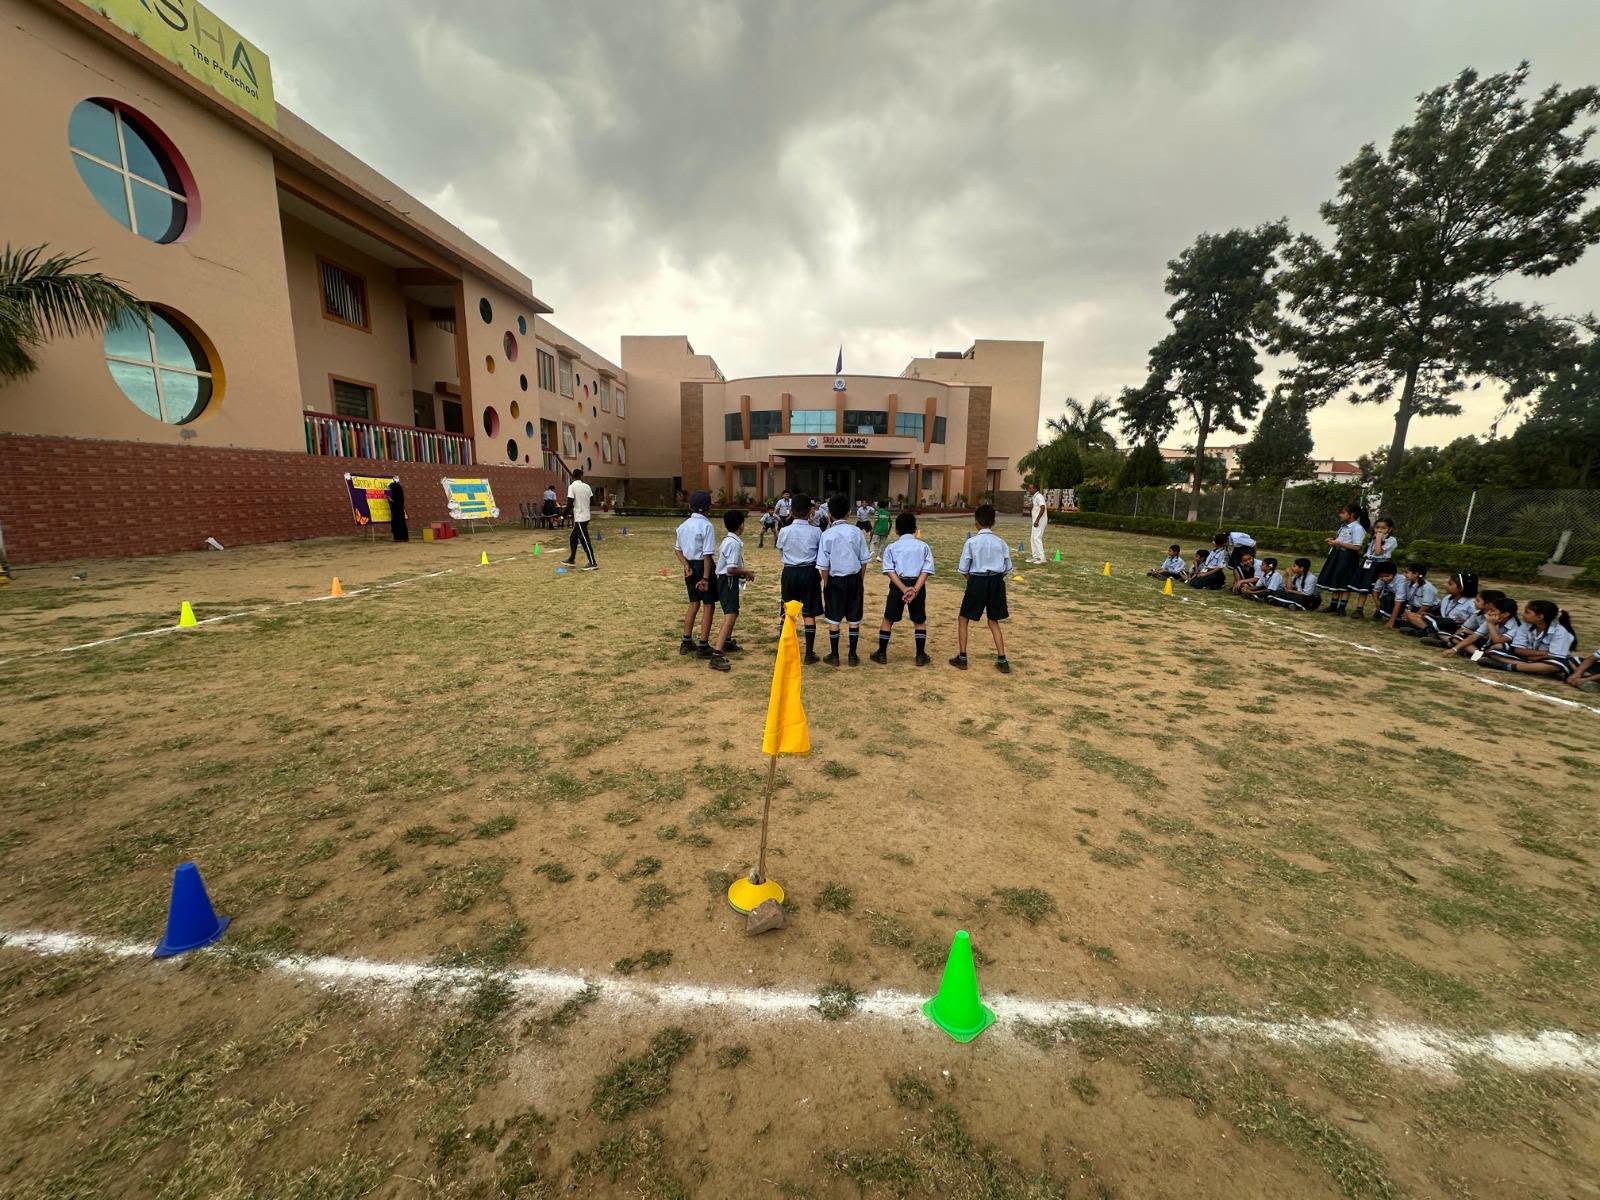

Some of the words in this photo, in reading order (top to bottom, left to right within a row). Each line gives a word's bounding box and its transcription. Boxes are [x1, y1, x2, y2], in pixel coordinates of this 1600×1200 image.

[140, 0, 258, 89] SHA
[190, 44, 210, 65] The
[213, 60, 259, 100] Preschool
